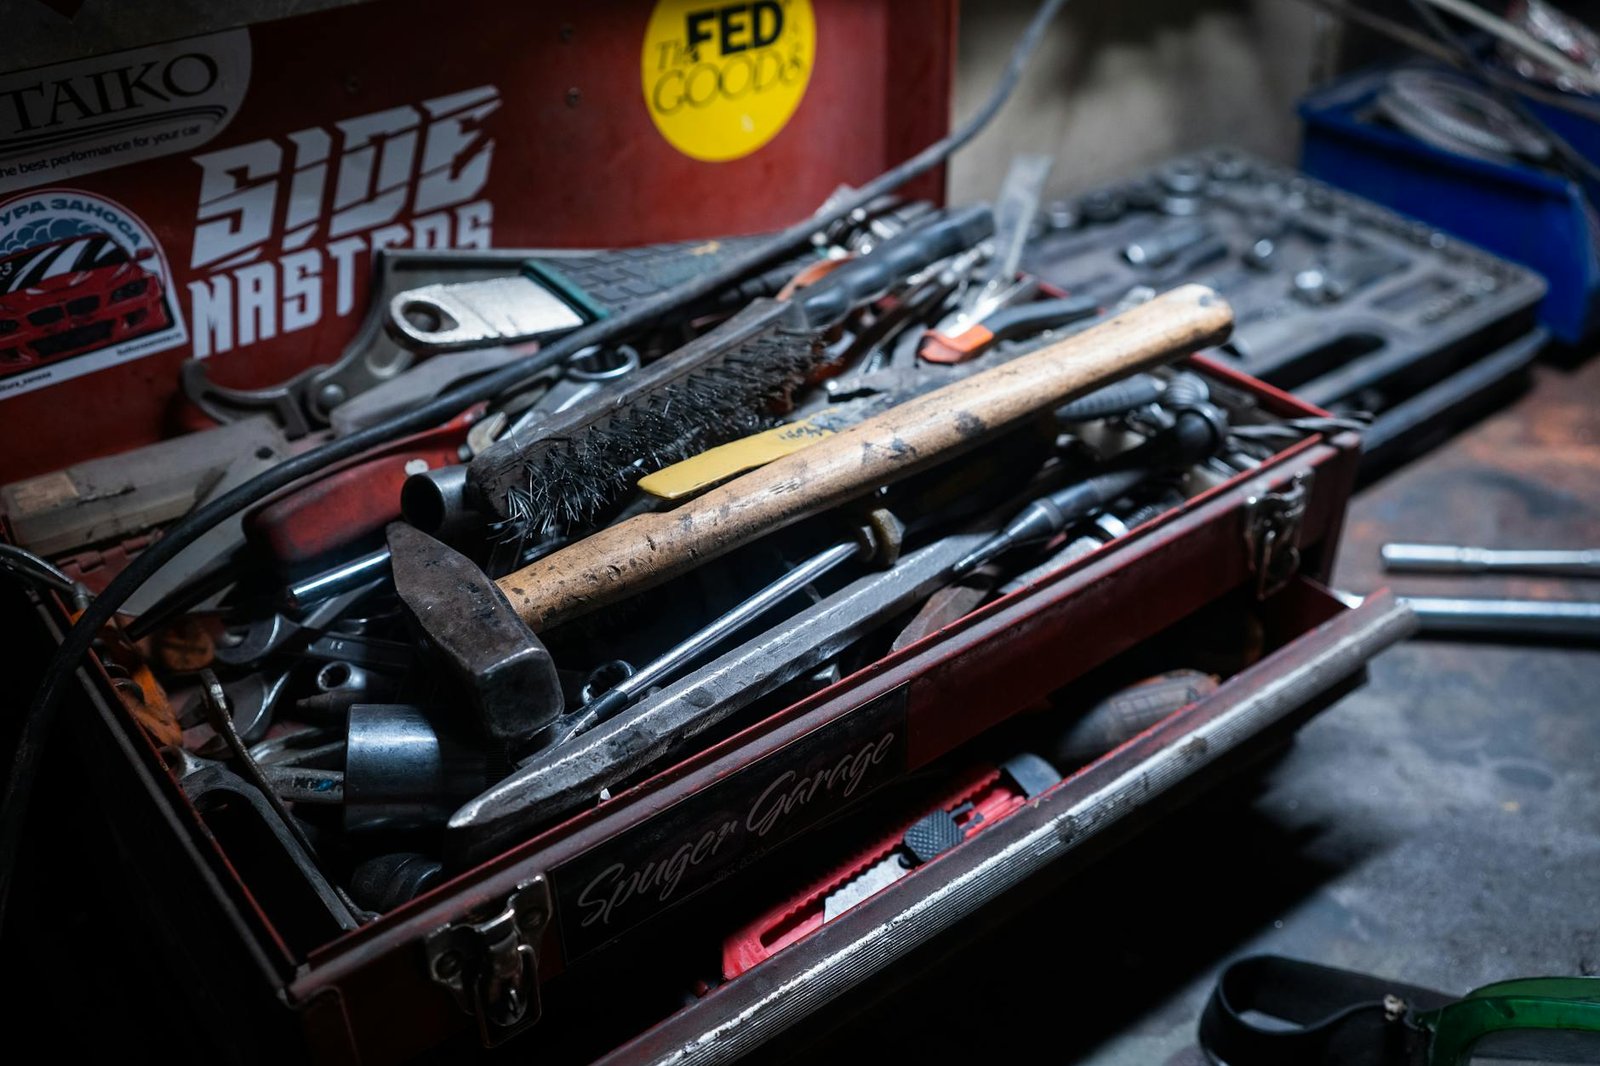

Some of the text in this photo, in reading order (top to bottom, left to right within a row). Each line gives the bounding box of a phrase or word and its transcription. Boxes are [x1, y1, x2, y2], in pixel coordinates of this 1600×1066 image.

[687, 2, 783, 55] FED
[0, 53, 218, 134] TAIKO
[652, 50, 801, 117] GOODS
[18, 158, 50, 174] best
[50, 141, 131, 169] performance
[132, 135, 150, 149] for
[152, 128, 181, 146] your
[182, 123, 202, 137] car
[191, 84, 502, 270] SIDE
[51, 198, 142, 247] ЗАНОСА
[745, 731, 896, 837] Garage
